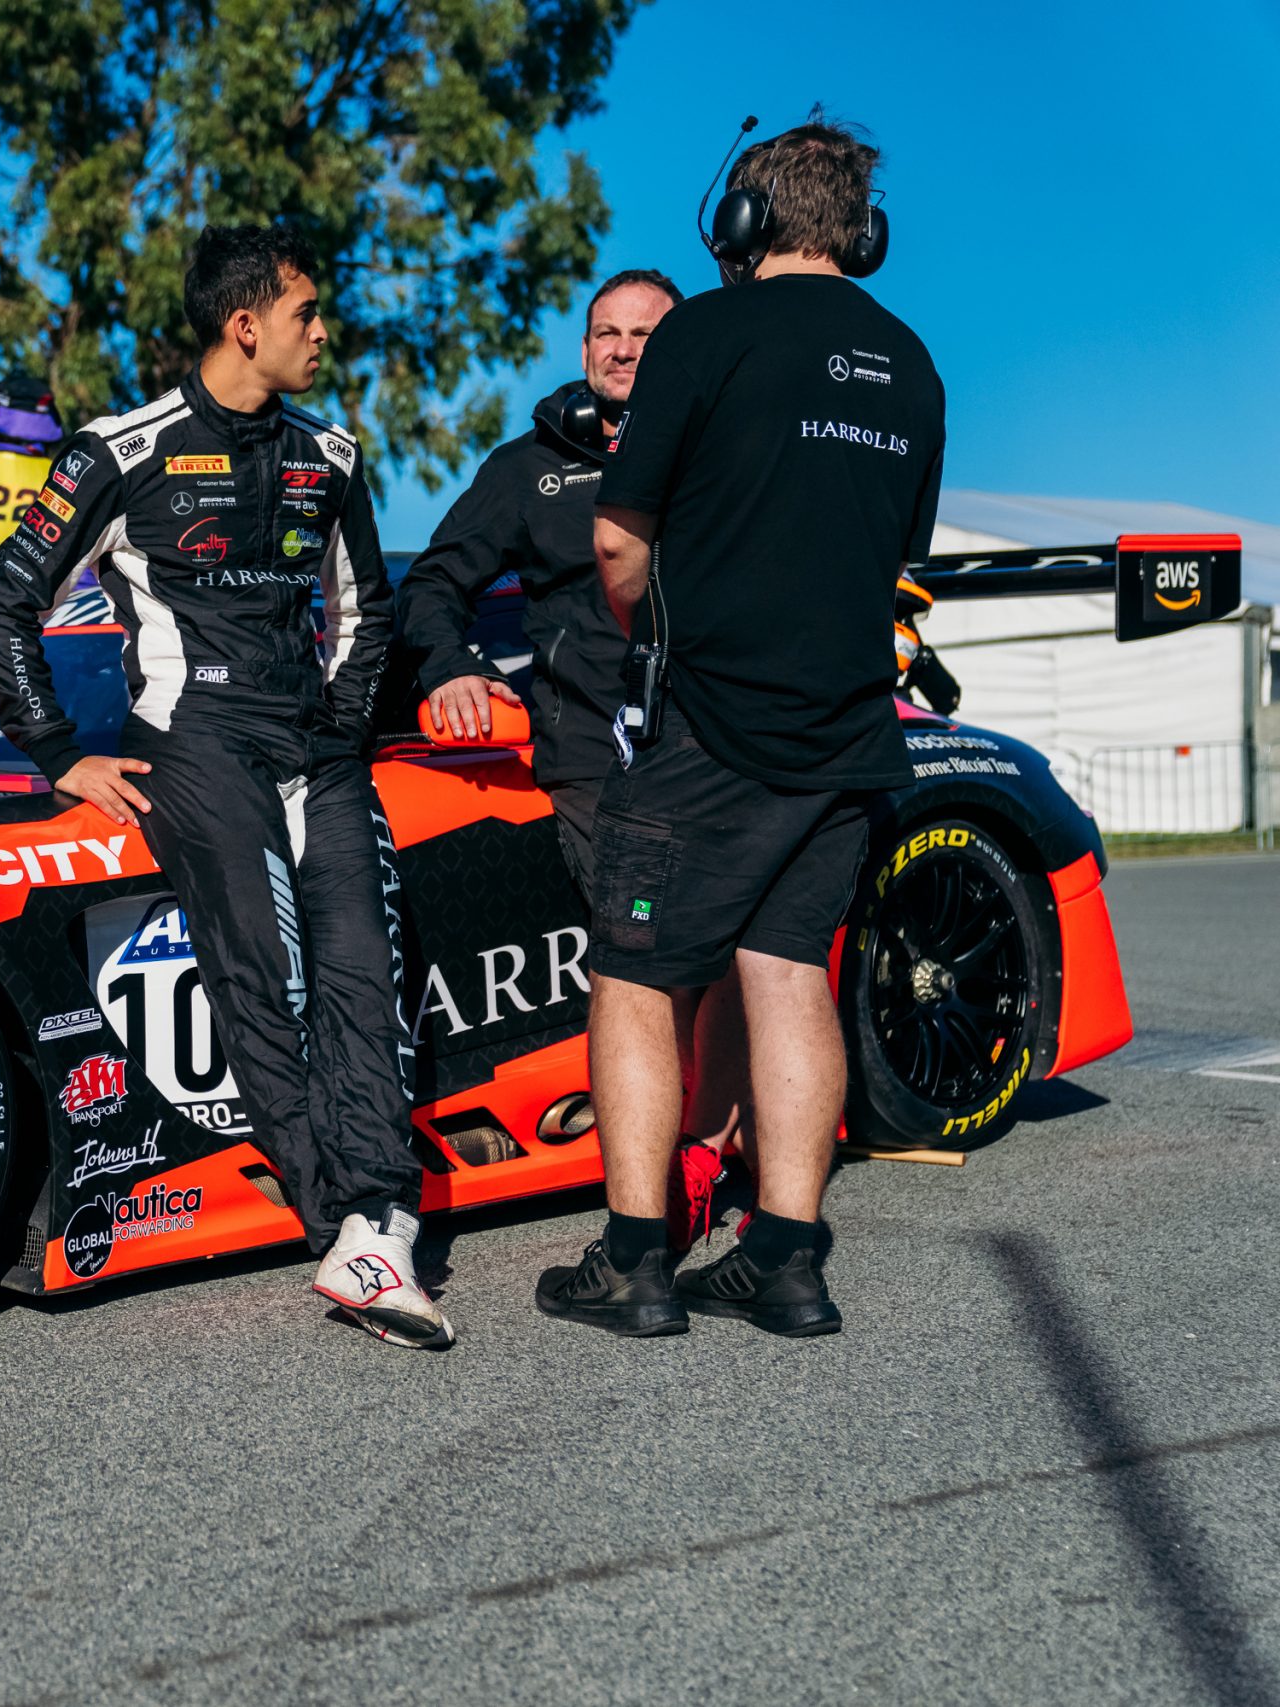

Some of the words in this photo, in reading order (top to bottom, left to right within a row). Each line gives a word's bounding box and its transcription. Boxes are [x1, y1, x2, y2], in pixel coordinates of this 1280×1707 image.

[119, 436, 146, 457] OMP
[327, 441, 352, 459] OMP
[801, 421, 908, 455] HARROLDS
[171, 458, 223, 471] PIRELLI
[281, 461, 329, 471] FANATEC
[1156, 561, 1199, 589] aws
[10, 637, 45, 720] HARRODS
[195, 669, 229, 683] OMP
[632, 910, 649, 920] FXD
[412, 926, 591, 1046] ARR
[40, 1010, 101, 1030] DIXCEL
[942, 1048, 1030, 1136] PIRELLI
[67, 1101, 127, 1127] TRANSPORT
[73, 1140, 137, 1188] Johnny
[95, 1183, 203, 1225] Nautica
[67, 1230, 112, 1253] GLOBAL
[112, 1214, 194, 1243] FORWARDING
